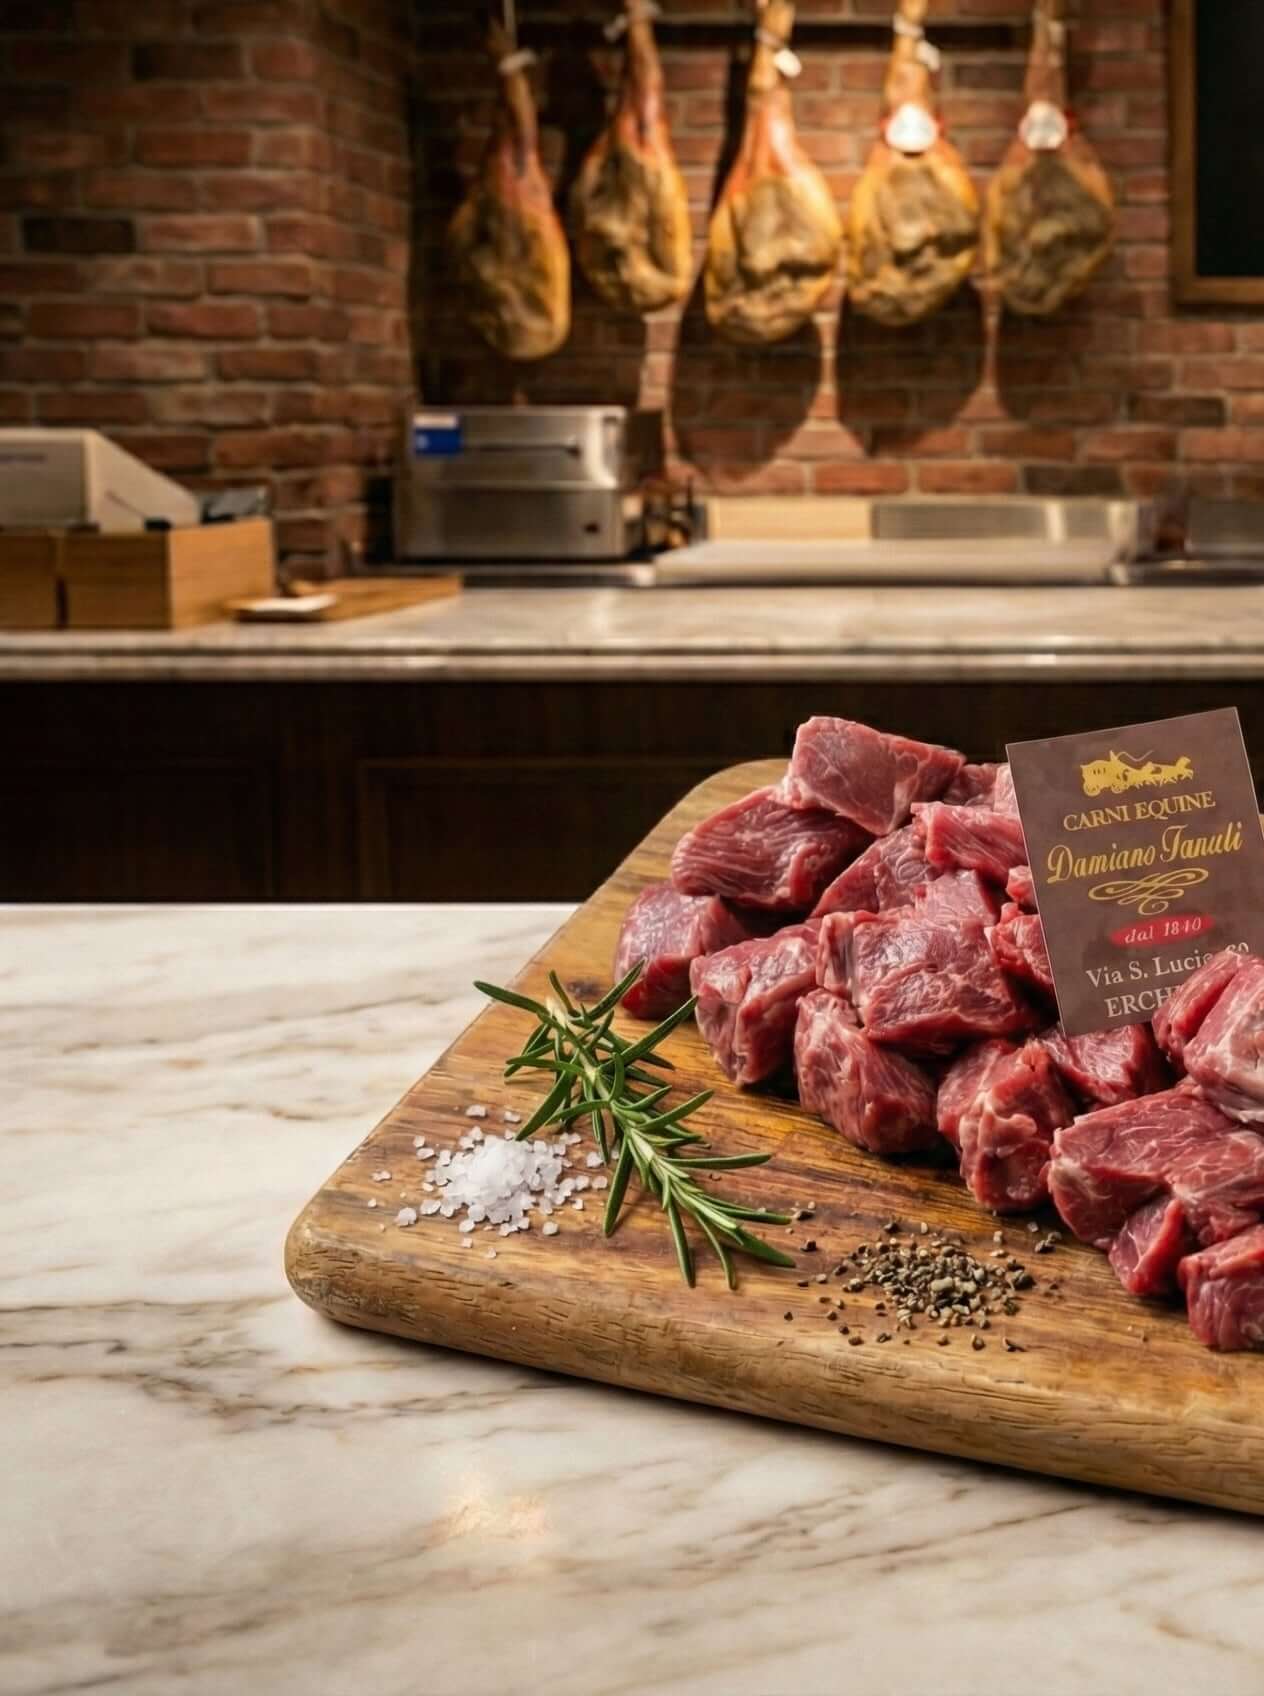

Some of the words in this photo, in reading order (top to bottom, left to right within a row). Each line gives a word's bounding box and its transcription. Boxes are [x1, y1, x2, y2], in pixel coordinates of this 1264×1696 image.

[1063, 805, 1131, 831] CARNI
[1134, 791, 1216, 820] EQUINE
[1047, 843, 1155, 884] Damiano
[1125, 925, 1153, 943] dal
[1085, 966, 1124, 988] Via
[1128, 960, 1148, 980] S.
[1104, 985, 1181, 1018] ERCH
